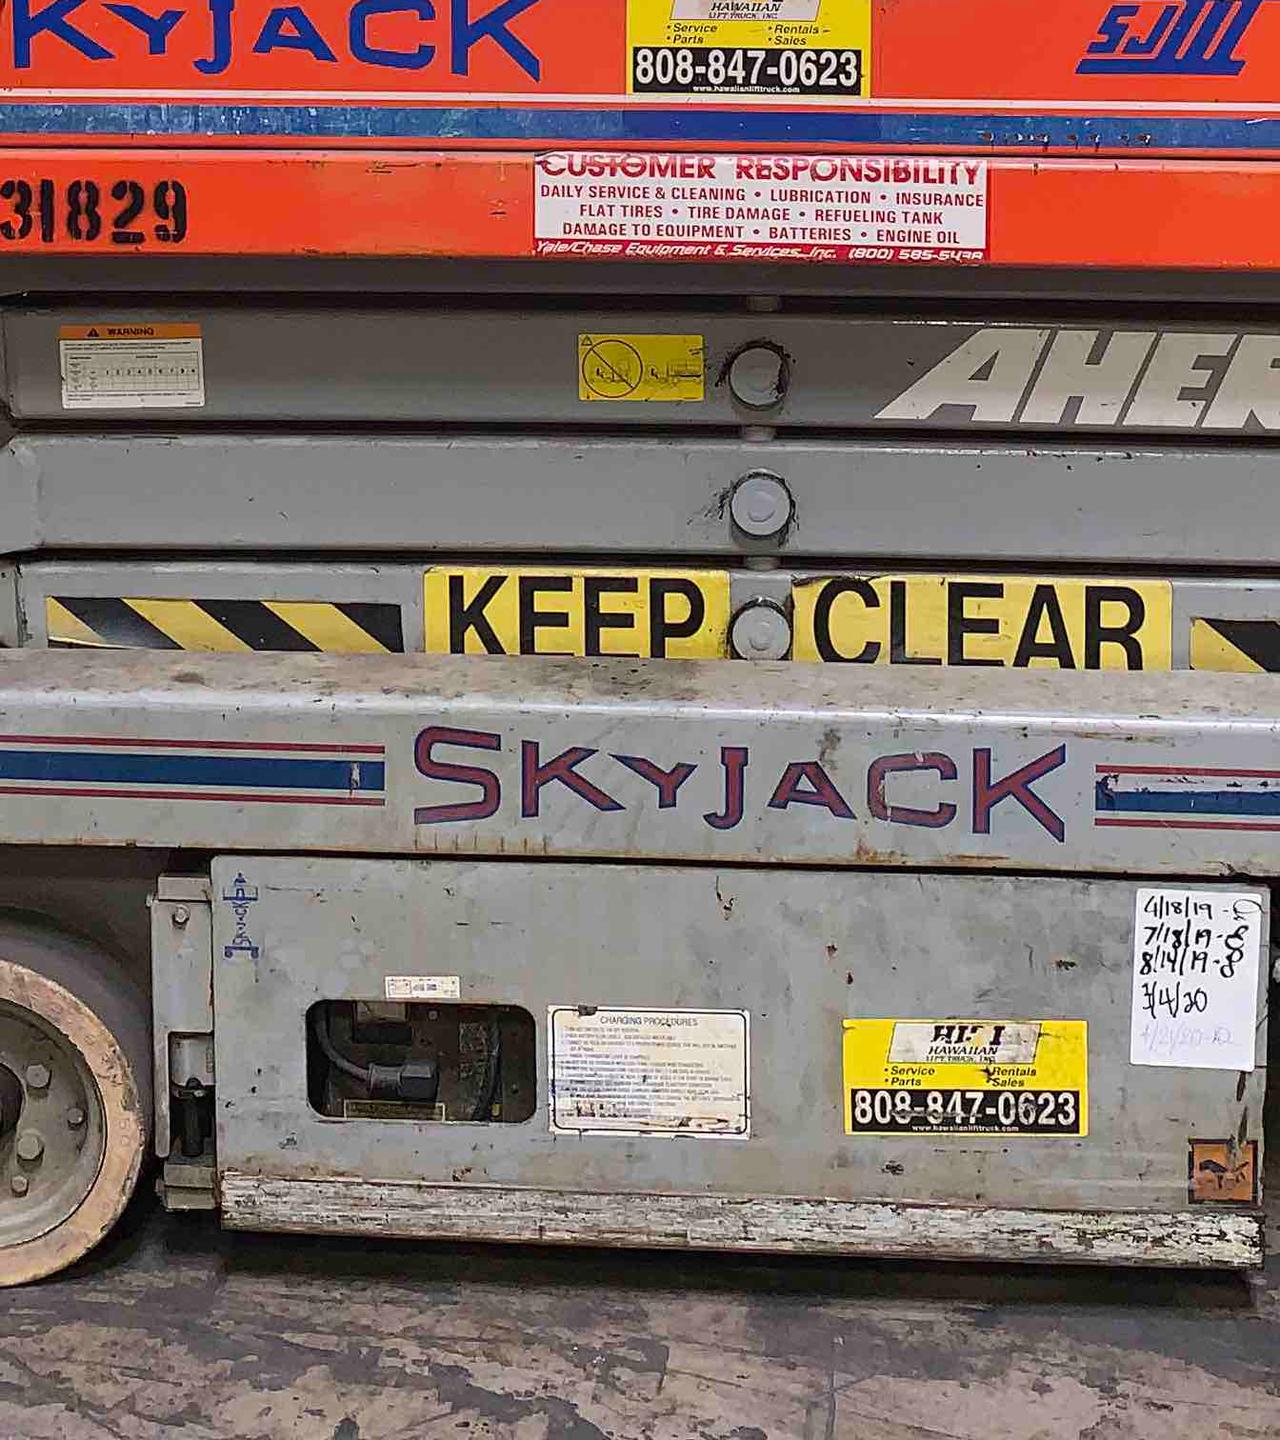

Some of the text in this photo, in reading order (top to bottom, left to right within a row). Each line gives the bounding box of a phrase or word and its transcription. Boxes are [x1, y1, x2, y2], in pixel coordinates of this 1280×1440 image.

[710, 2, 781, 12] HAWAIIAN
[672, 23, 819, 35] Service Rentals
[672, 35, 807, 46] Parts Sales
[635, 48, 858, 87] 808-847-0623
[540, 154, 980, 185] CUSTOMER RESPONSIBILITY
[540, 185, 984, 207] DAILY SERVICE & CLEANING LUBRICATION INSURANCE
[579, 204, 944, 225] FLAT TIRES TIRE DAMAGE REFUELING TANK
[562, 222, 960, 244] DAMAGE TO EQUIPMENT BATTERIES ENGINE OIL
[536, 240, 623, 255] Yale/Chase
[625, 242, 711, 257] Equipment
[848, 248, 894, 260] (800)
[107, 328, 154, 337] WARNING
[447, 574, 1147, 671] KEEP CLEAR
[413, 725, 1066, 843] SKYJACK
[600, 1015, 699, 1027] CHARGING PROCEDURES
[928, 1046, 999, 1055] HAWAIIAN
[890, 1065, 1037, 1076] Service Rentals
[890, 1076, 1025, 1088] Parts Sales
[854, 1090, 1076, 1126] 808-847-0623
